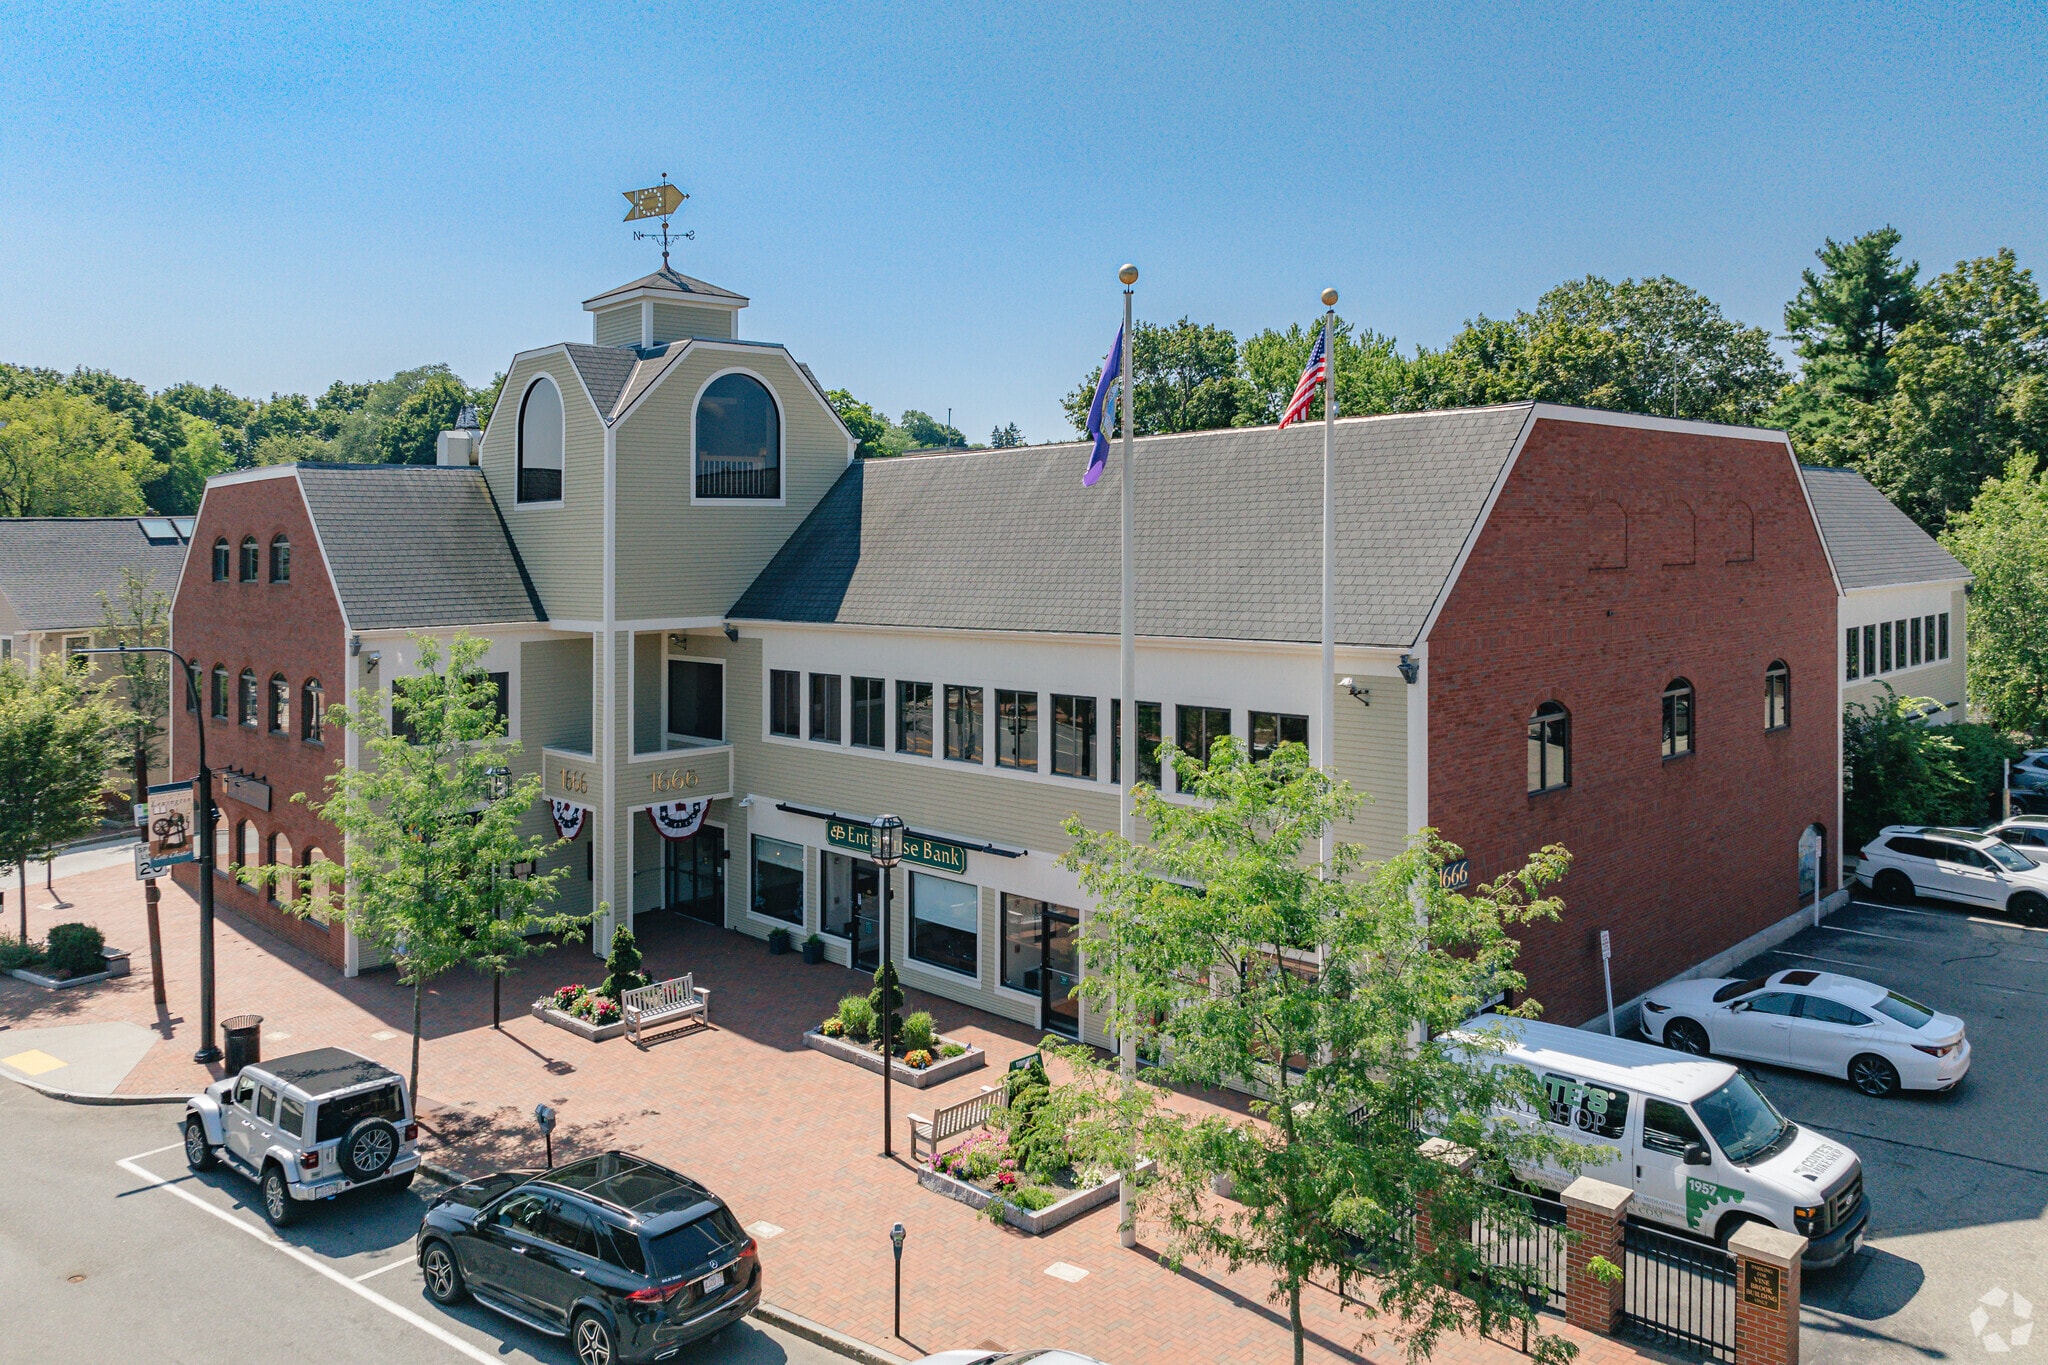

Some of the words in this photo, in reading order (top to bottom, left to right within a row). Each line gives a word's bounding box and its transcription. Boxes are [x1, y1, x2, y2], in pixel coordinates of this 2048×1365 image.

[633, 231, 641, 241] N
[560, 767, 588, 794] 1666
[649, 768, 699, 793] 1666
[923, 841, 960, 866] Bank
[1438, 861, 1468, 888] 1666
[1689, 1179, 1717, 1196] 1957
[1751, 1283, 1773, 1295] BROOK
[1754, 1277, 1770, 1287] VINE
[1746, 1288, 1778, 1303] BUILDING
